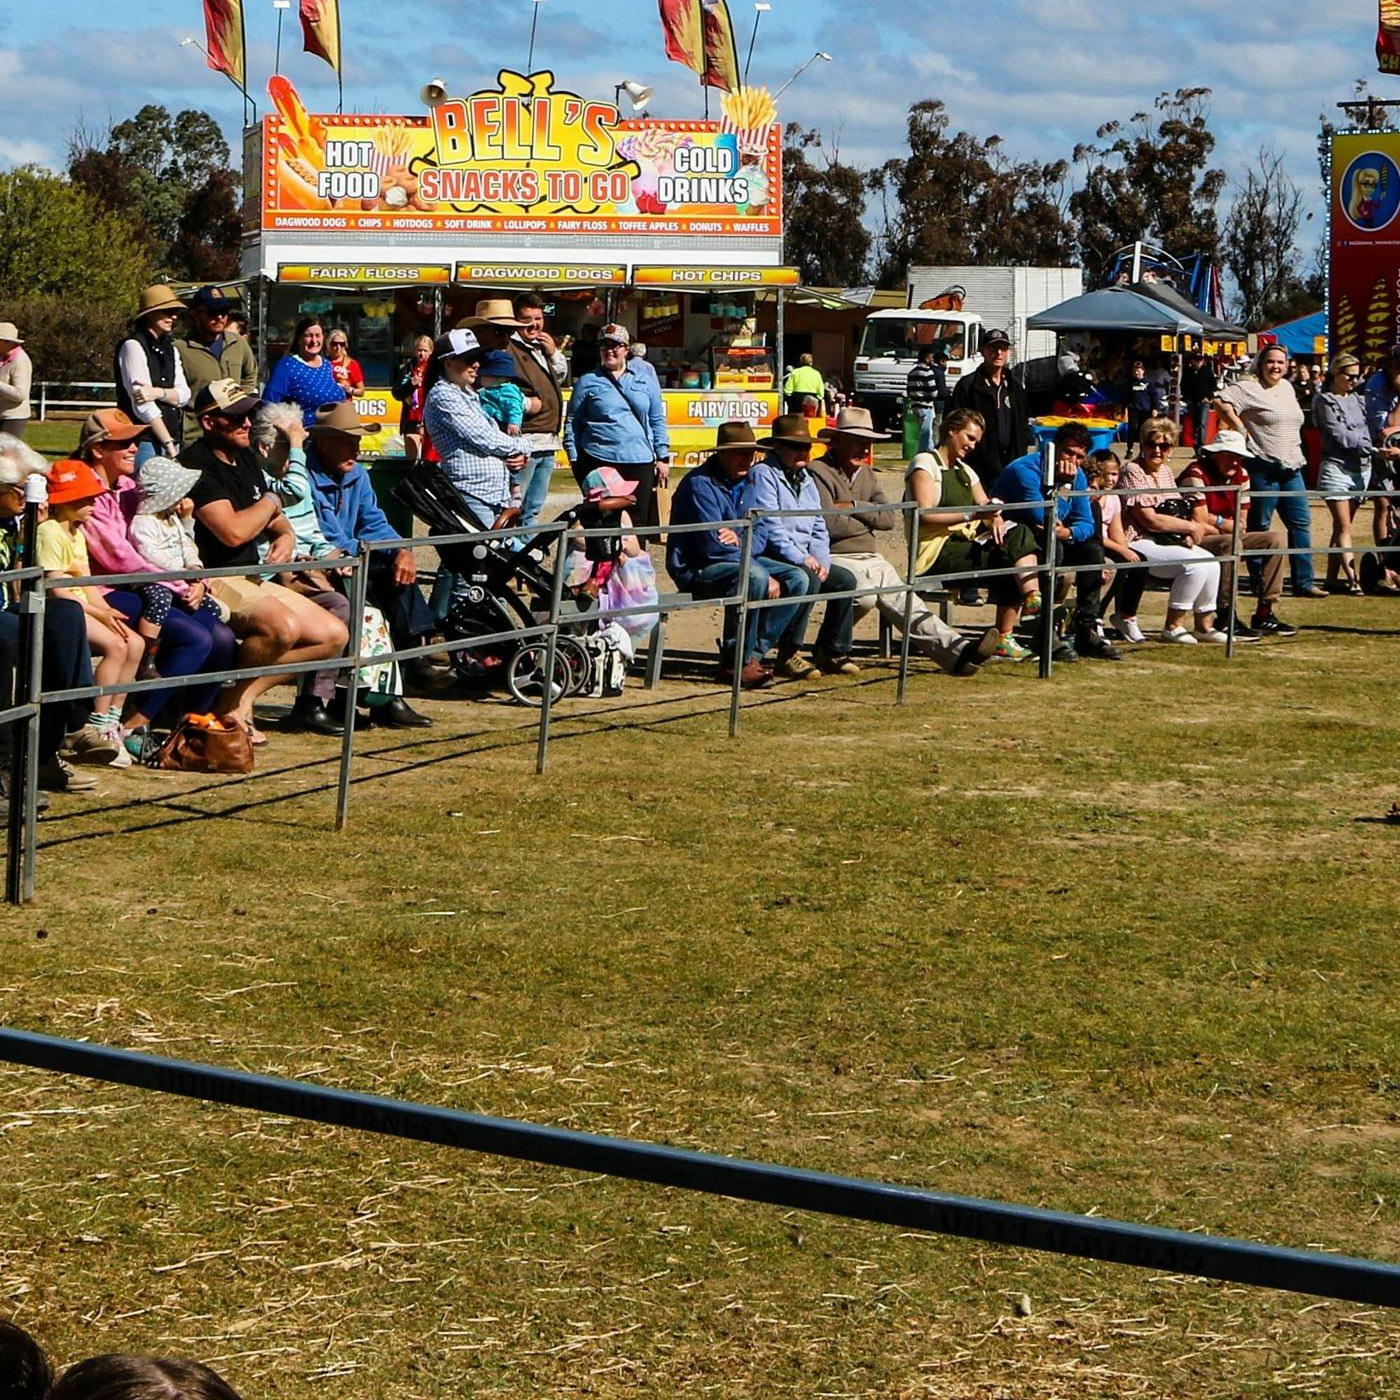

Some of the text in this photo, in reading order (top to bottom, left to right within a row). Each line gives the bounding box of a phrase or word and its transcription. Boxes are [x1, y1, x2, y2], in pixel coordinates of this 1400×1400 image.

[431, 97, 618, 166] BELL'S
[326, 141, 373, 167] HOT
[673, 147, 733, 173] COLD
[318, 172, 380, 199] FOOD
[420, 168, 630, 204] SNACKS TO GO
[658, 177, 749, 204] DRINKS
[275, 217, 770, 232] DAGWOOD DOGS CHIPS HOTDOGS SOFT DRINK LOLLIPOPS FAIRY FLOSS TOFFEE APPLES DONUTS WAFFLES
[309, 267, 420, 280] FAIRY FLOSS
[470, 267, 614, 281] DAGWOOD DOGS
[672, 270, 762, 282] HOT CHIPS
[688, 400, 728, 418] FAIRY
[729, 400, 769, 418] FLOSS
